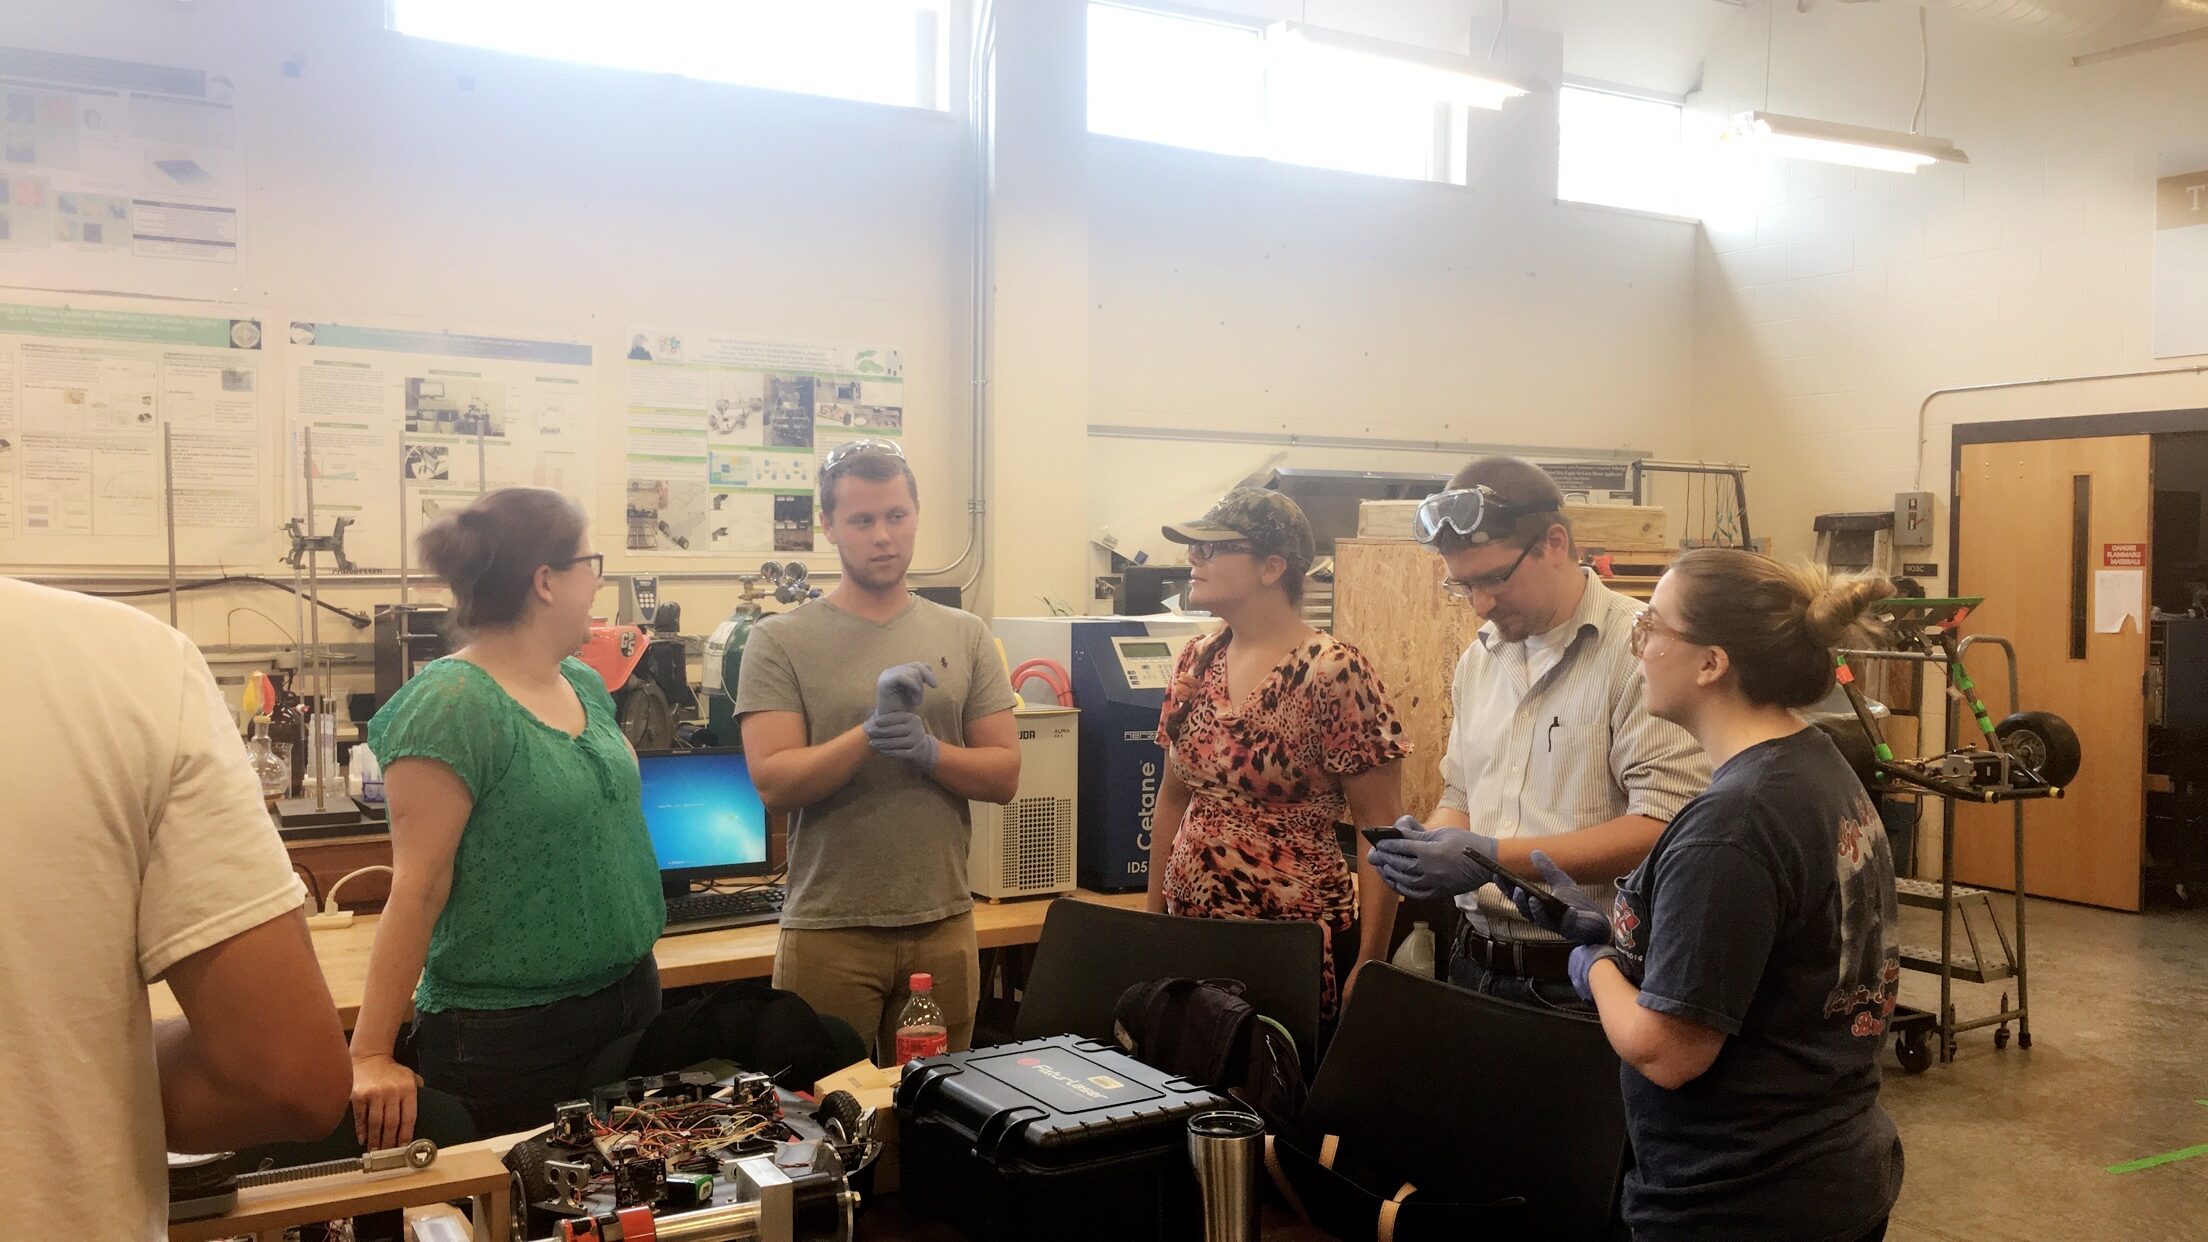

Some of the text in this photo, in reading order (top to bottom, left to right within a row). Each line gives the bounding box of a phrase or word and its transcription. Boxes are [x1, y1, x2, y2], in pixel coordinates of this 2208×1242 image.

[2186, 184, 2208, 211] T
[1905, 564, 1926, 572] 1103C
[1136, 761, 1156, 851] Cetane
[1127, 861, 1148, 874] ID5
